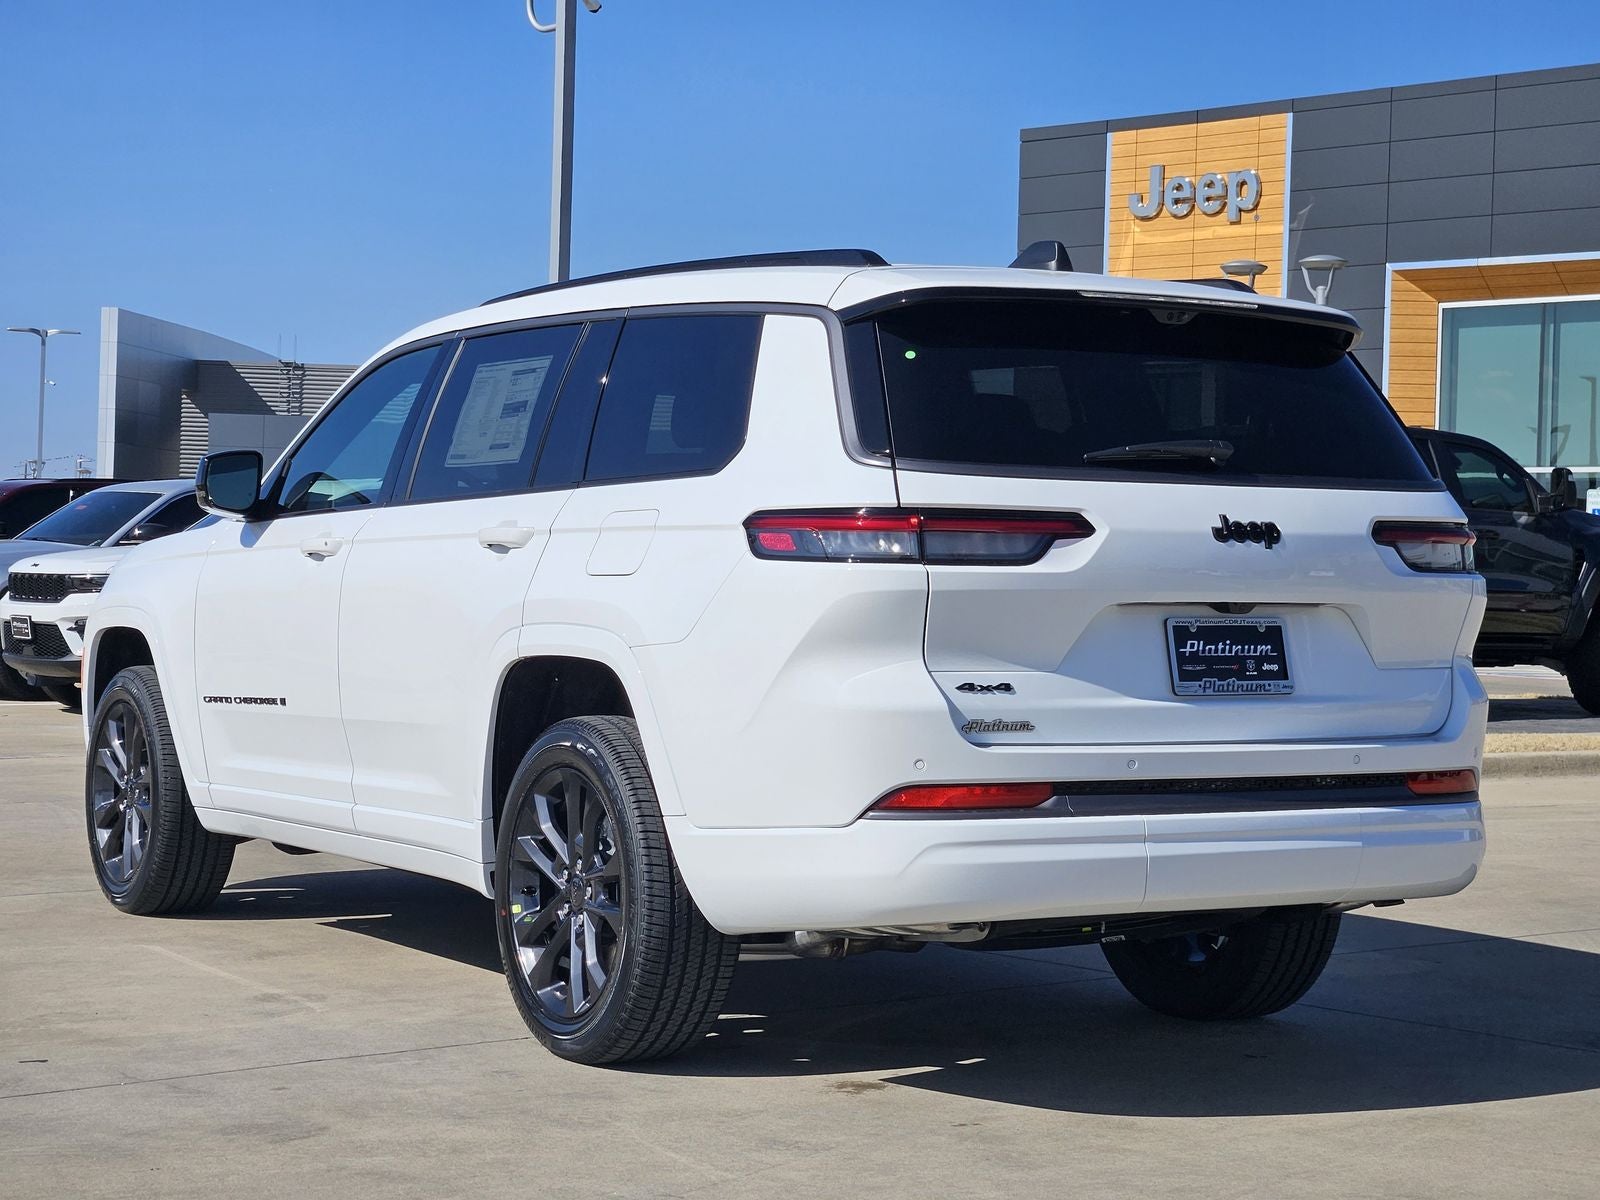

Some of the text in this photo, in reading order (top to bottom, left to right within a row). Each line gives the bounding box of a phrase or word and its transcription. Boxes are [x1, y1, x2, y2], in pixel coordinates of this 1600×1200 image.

[1128, 164, 1262, 225] Jeep
[1211, 513, 1282, 550] Jeep
[1179, 640, 1277, 656] Platinum
[1261, 662, 1279, 672] Jeep
[955, 682, 1015, 693] 4x4
[1202, 678, 1271, 693] Platinum
[234, 697, 278, 705] CHEROKEE
[962, 718, 1036, 734] Platinum
